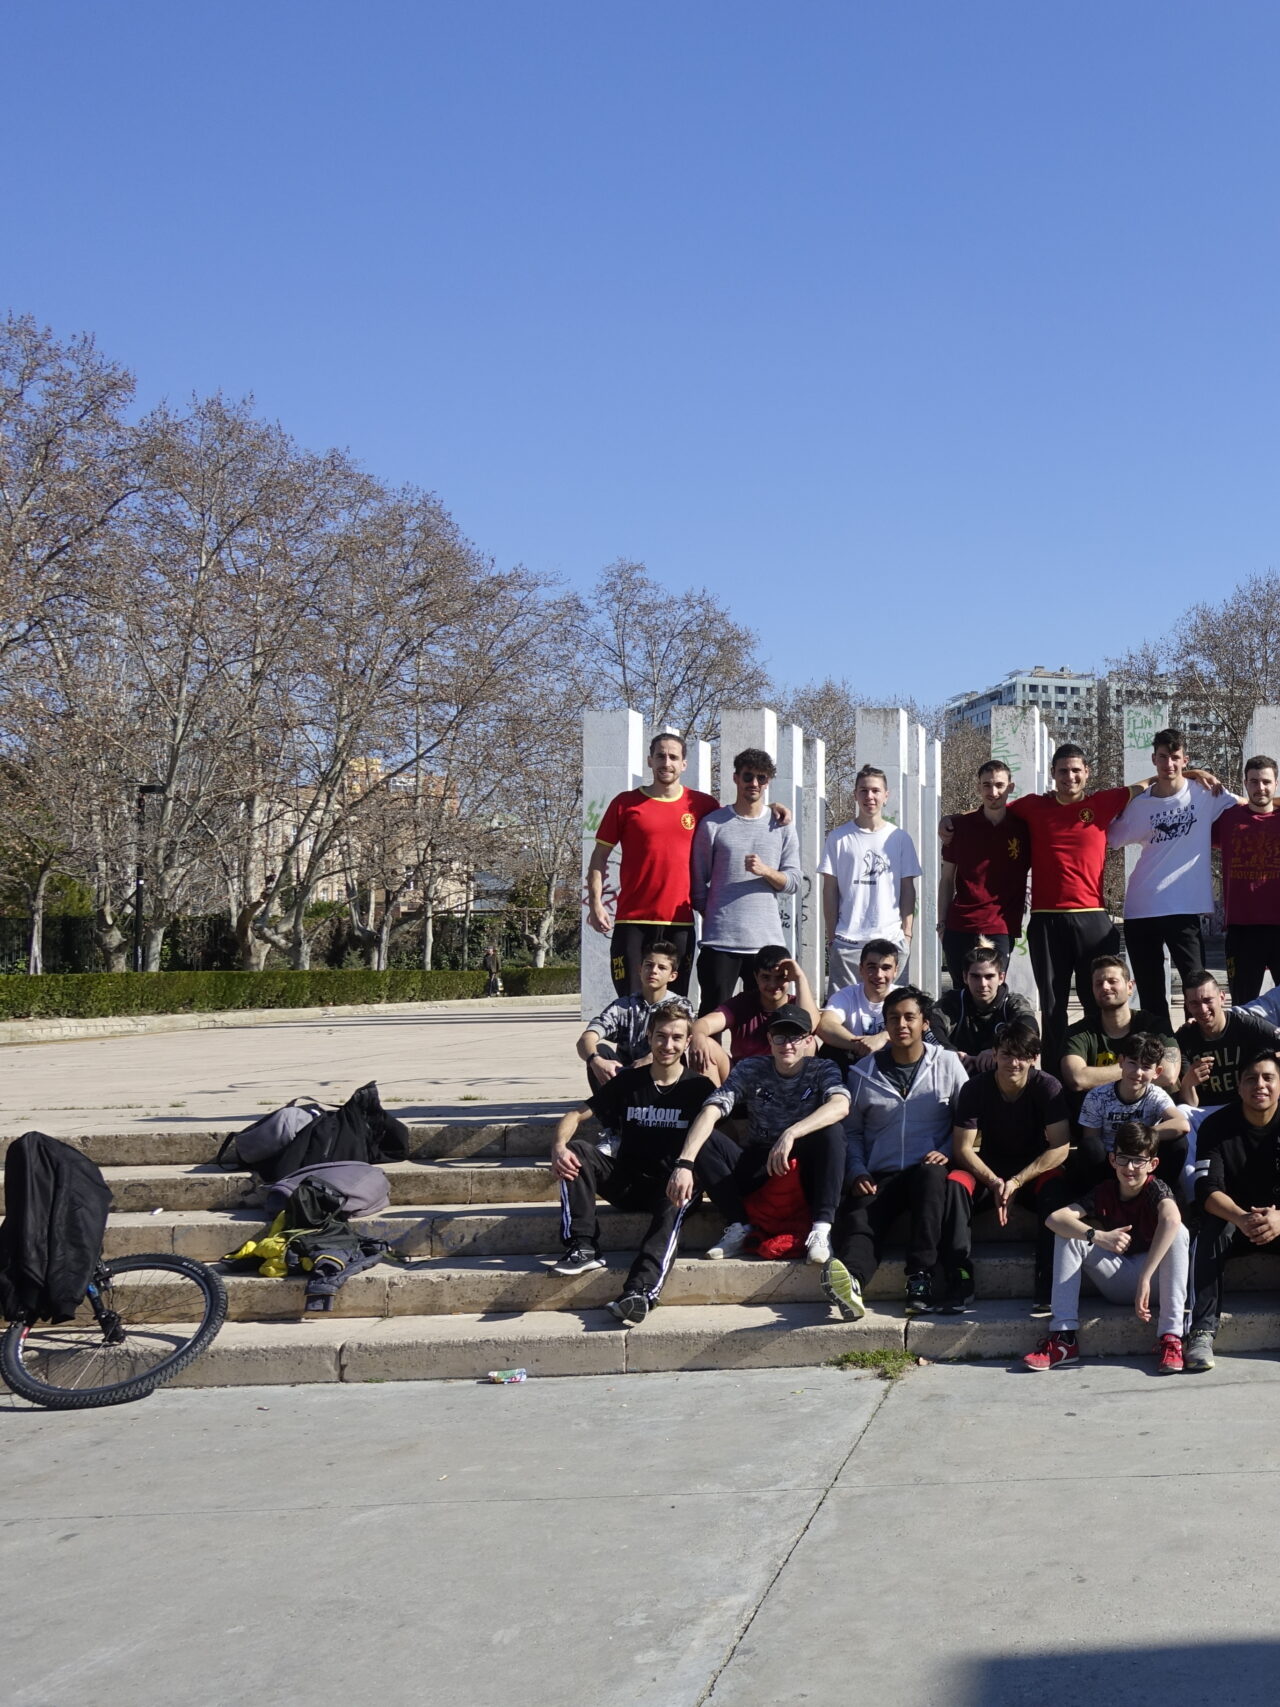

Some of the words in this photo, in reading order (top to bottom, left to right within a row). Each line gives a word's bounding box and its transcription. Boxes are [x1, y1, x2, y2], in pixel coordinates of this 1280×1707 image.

[612, 955, 625, 968] PK
[613, 968, 626, 981] ZM
[626, 1105, 682, 1121] parkour
